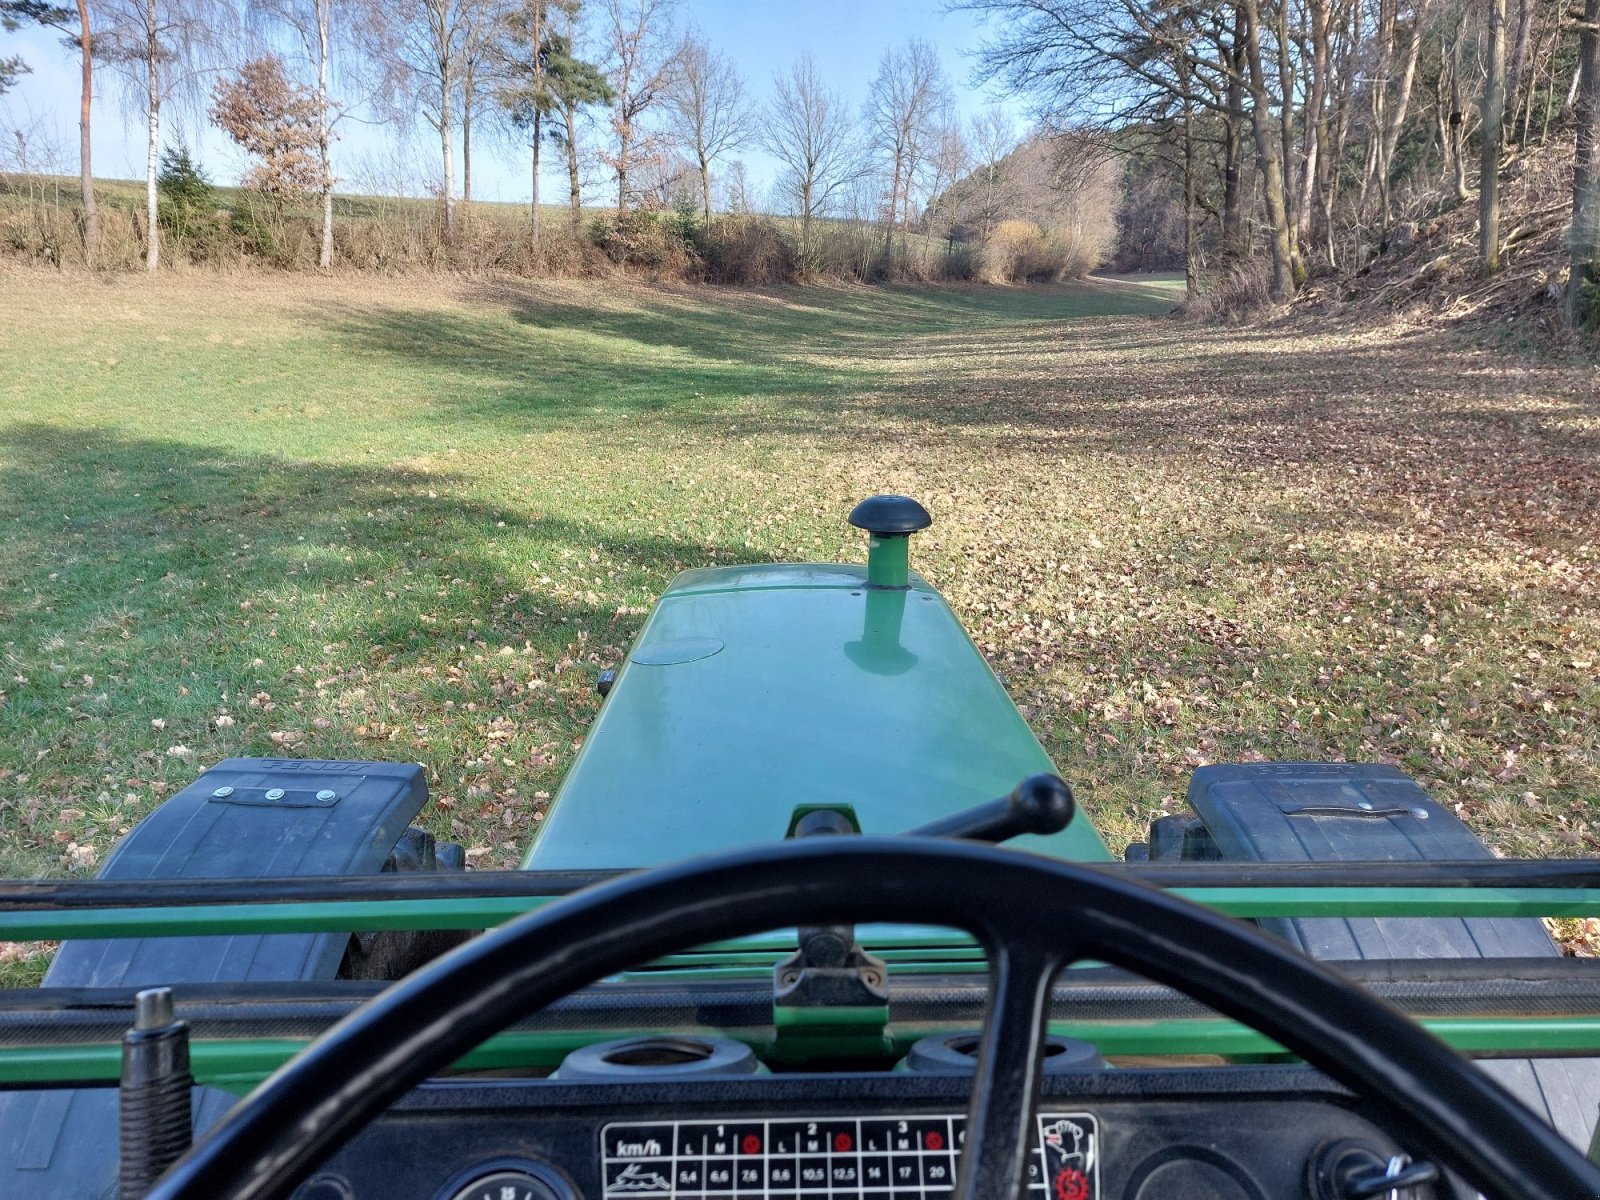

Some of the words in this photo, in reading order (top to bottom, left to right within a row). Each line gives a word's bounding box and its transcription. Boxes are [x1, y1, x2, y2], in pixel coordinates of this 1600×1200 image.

[258, 759, 374, 771] FENDT
[717, 1125, 725, 1137] 1
[807, 1123, 818, 1135] 2
[898, 1120, 908, 1133] 3
[616, 1139, 661, 1157] km/h
[685, 1143, 693, 1155] L
[714, 1142, 726, 1154] M
[778, 1141, 786, 1152] L
[807, 1140, 818, 1152] M
[869, 1139, 877, 1151] L
[898, 1139, 909, 1150] M
[899, 1166, 911, 1179] 17
[929, 1166, 946, 1179] 20
